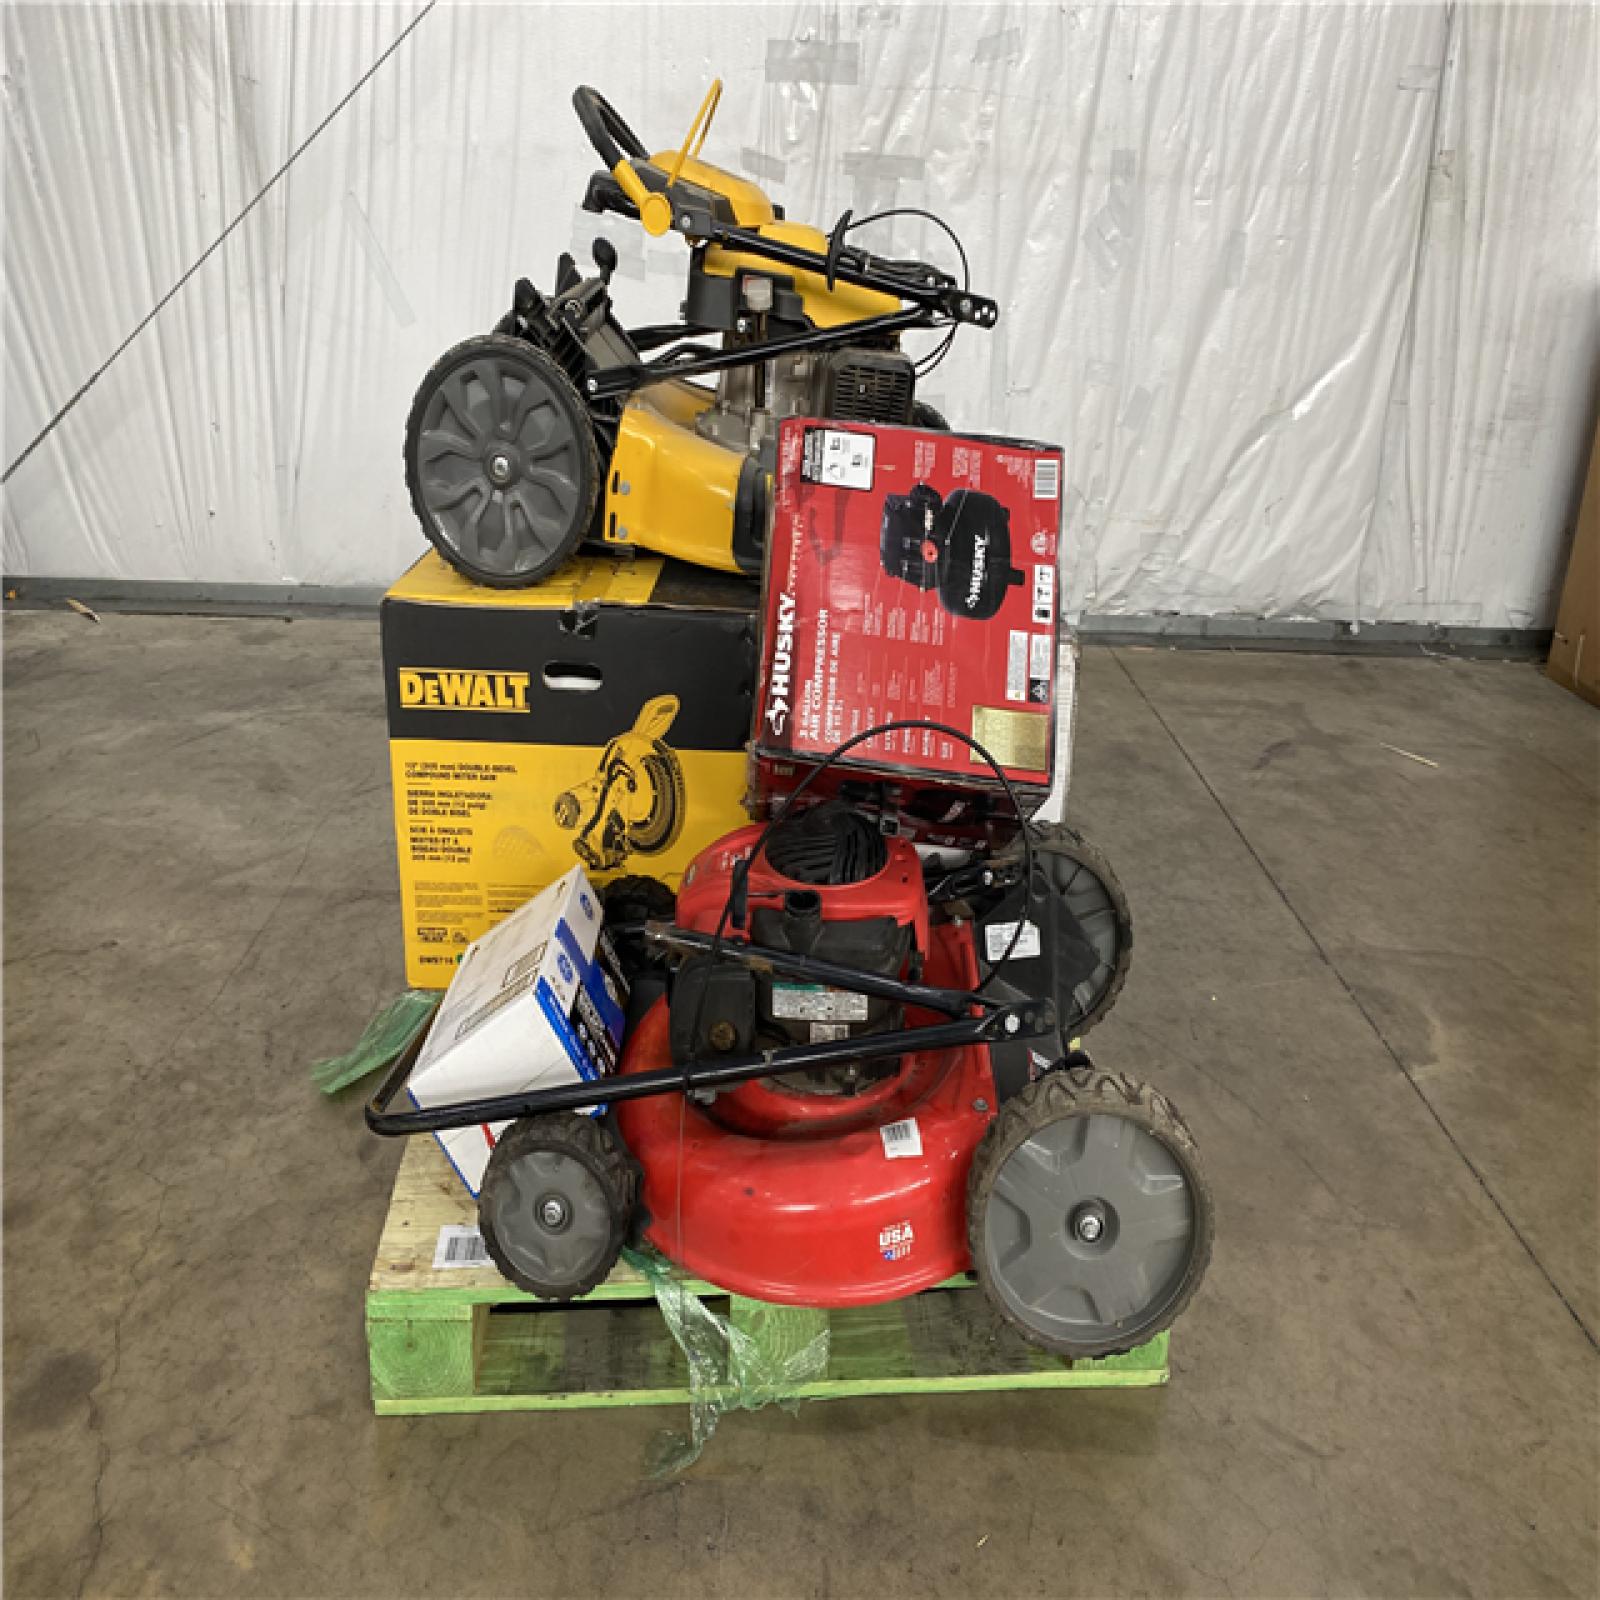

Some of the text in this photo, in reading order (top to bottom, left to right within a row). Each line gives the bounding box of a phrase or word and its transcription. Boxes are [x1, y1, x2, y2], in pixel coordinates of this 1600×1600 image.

[970, 534, 986, 595] HUSKY
[771, 592, 797, 696] HUSKY
[809, 608, 828, 740] AIR COMPRESSOR
[879, 1222, 913, 1246] USA
